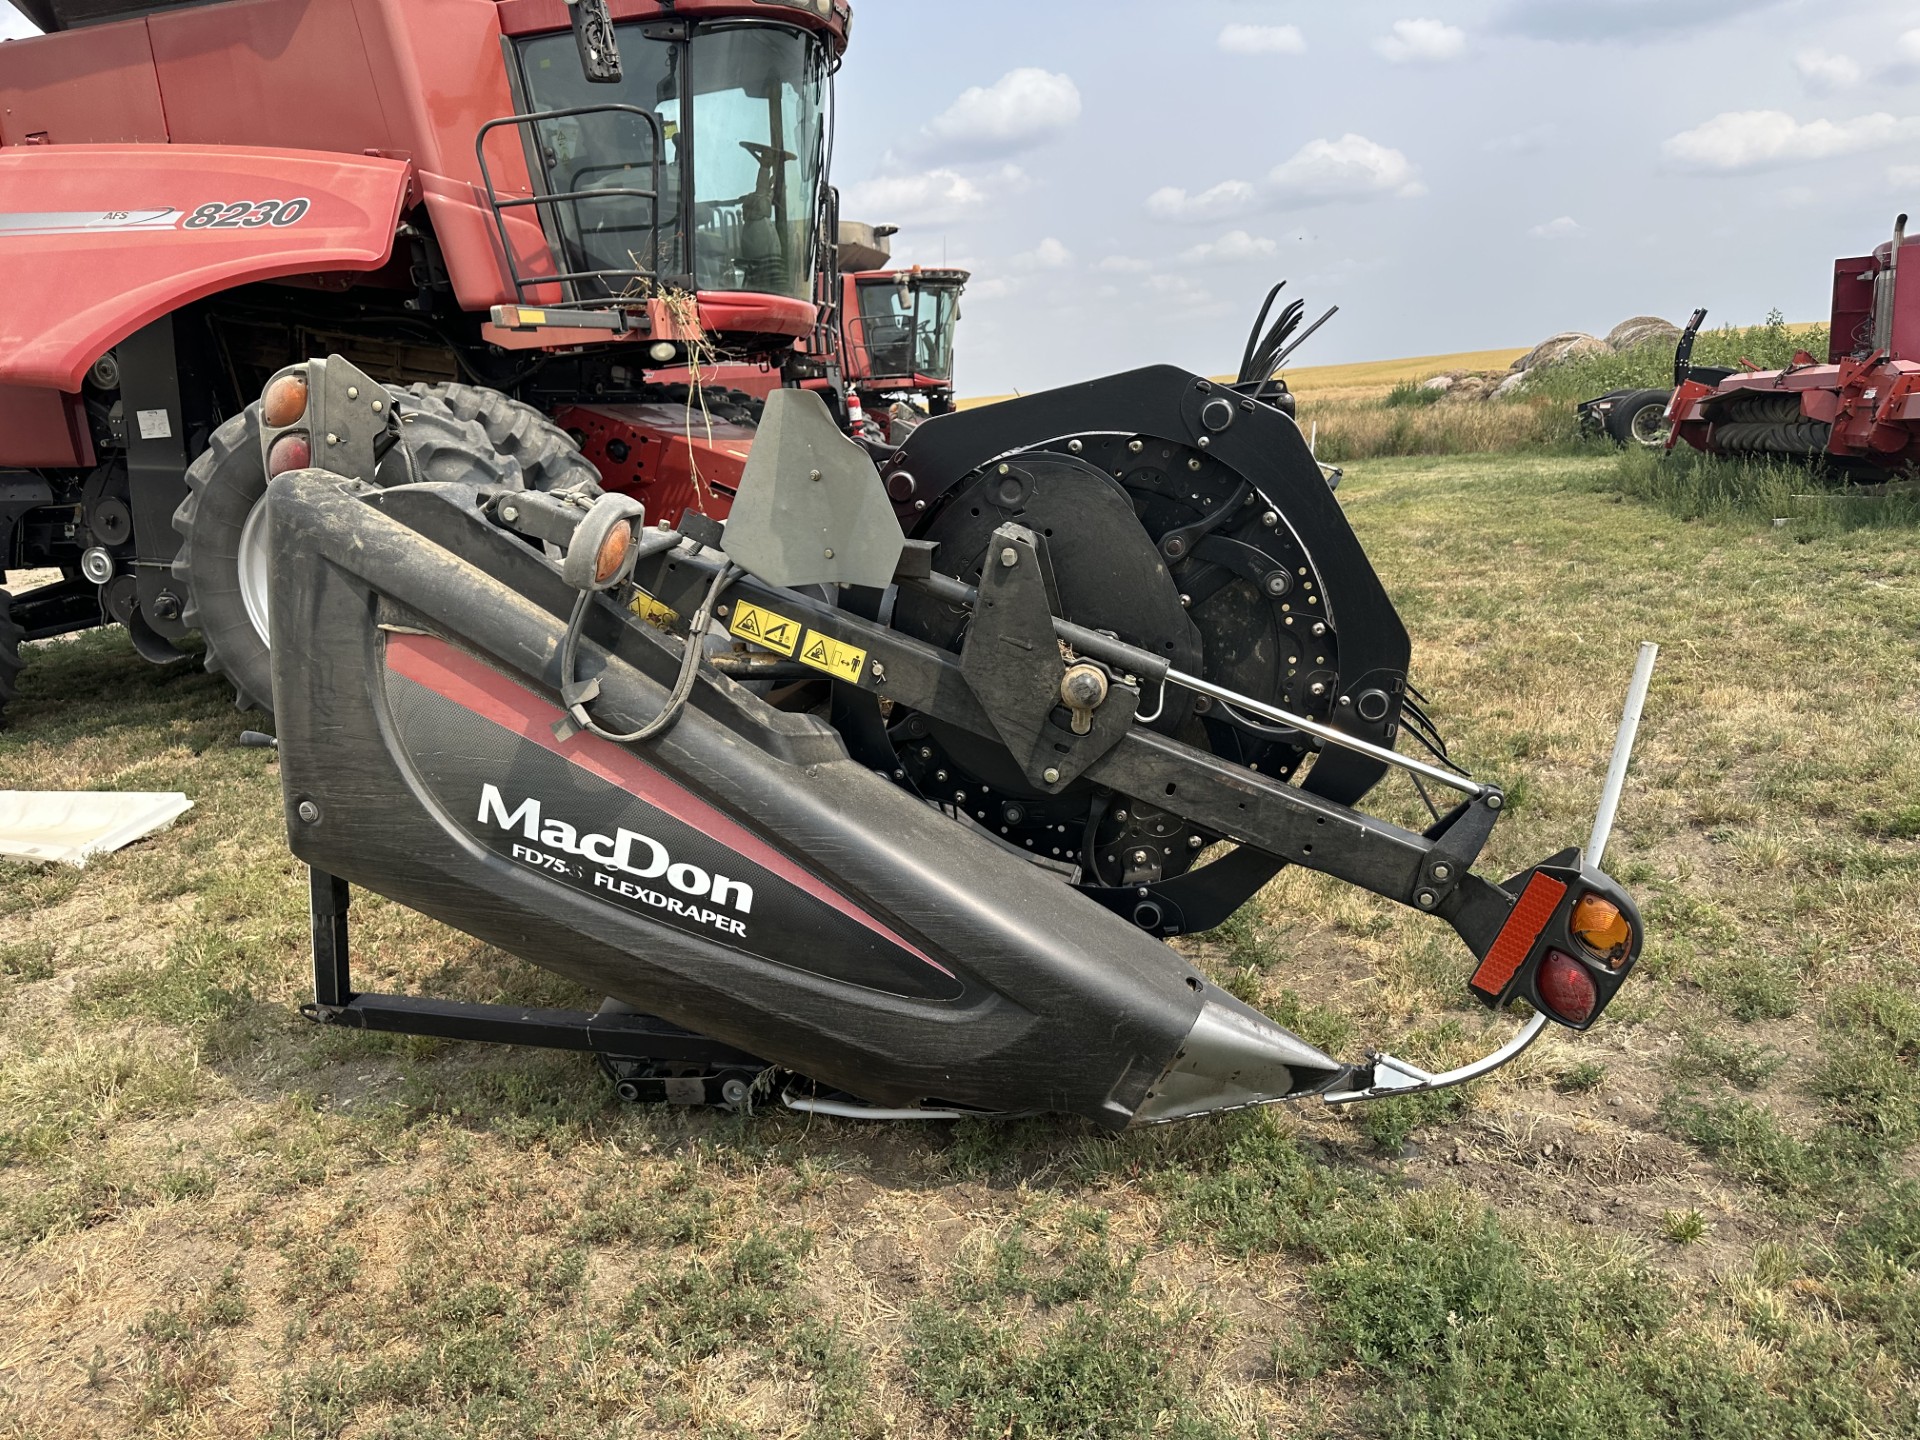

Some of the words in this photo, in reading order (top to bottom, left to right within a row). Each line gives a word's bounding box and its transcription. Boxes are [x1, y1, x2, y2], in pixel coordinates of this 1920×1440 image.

[103, 211, 129, 220] AFS
[184, 198, 311, 229] 8230
[477, 783, 754, 913] MacDon
[594, 872, 747, 938] FLEXDRAPER
